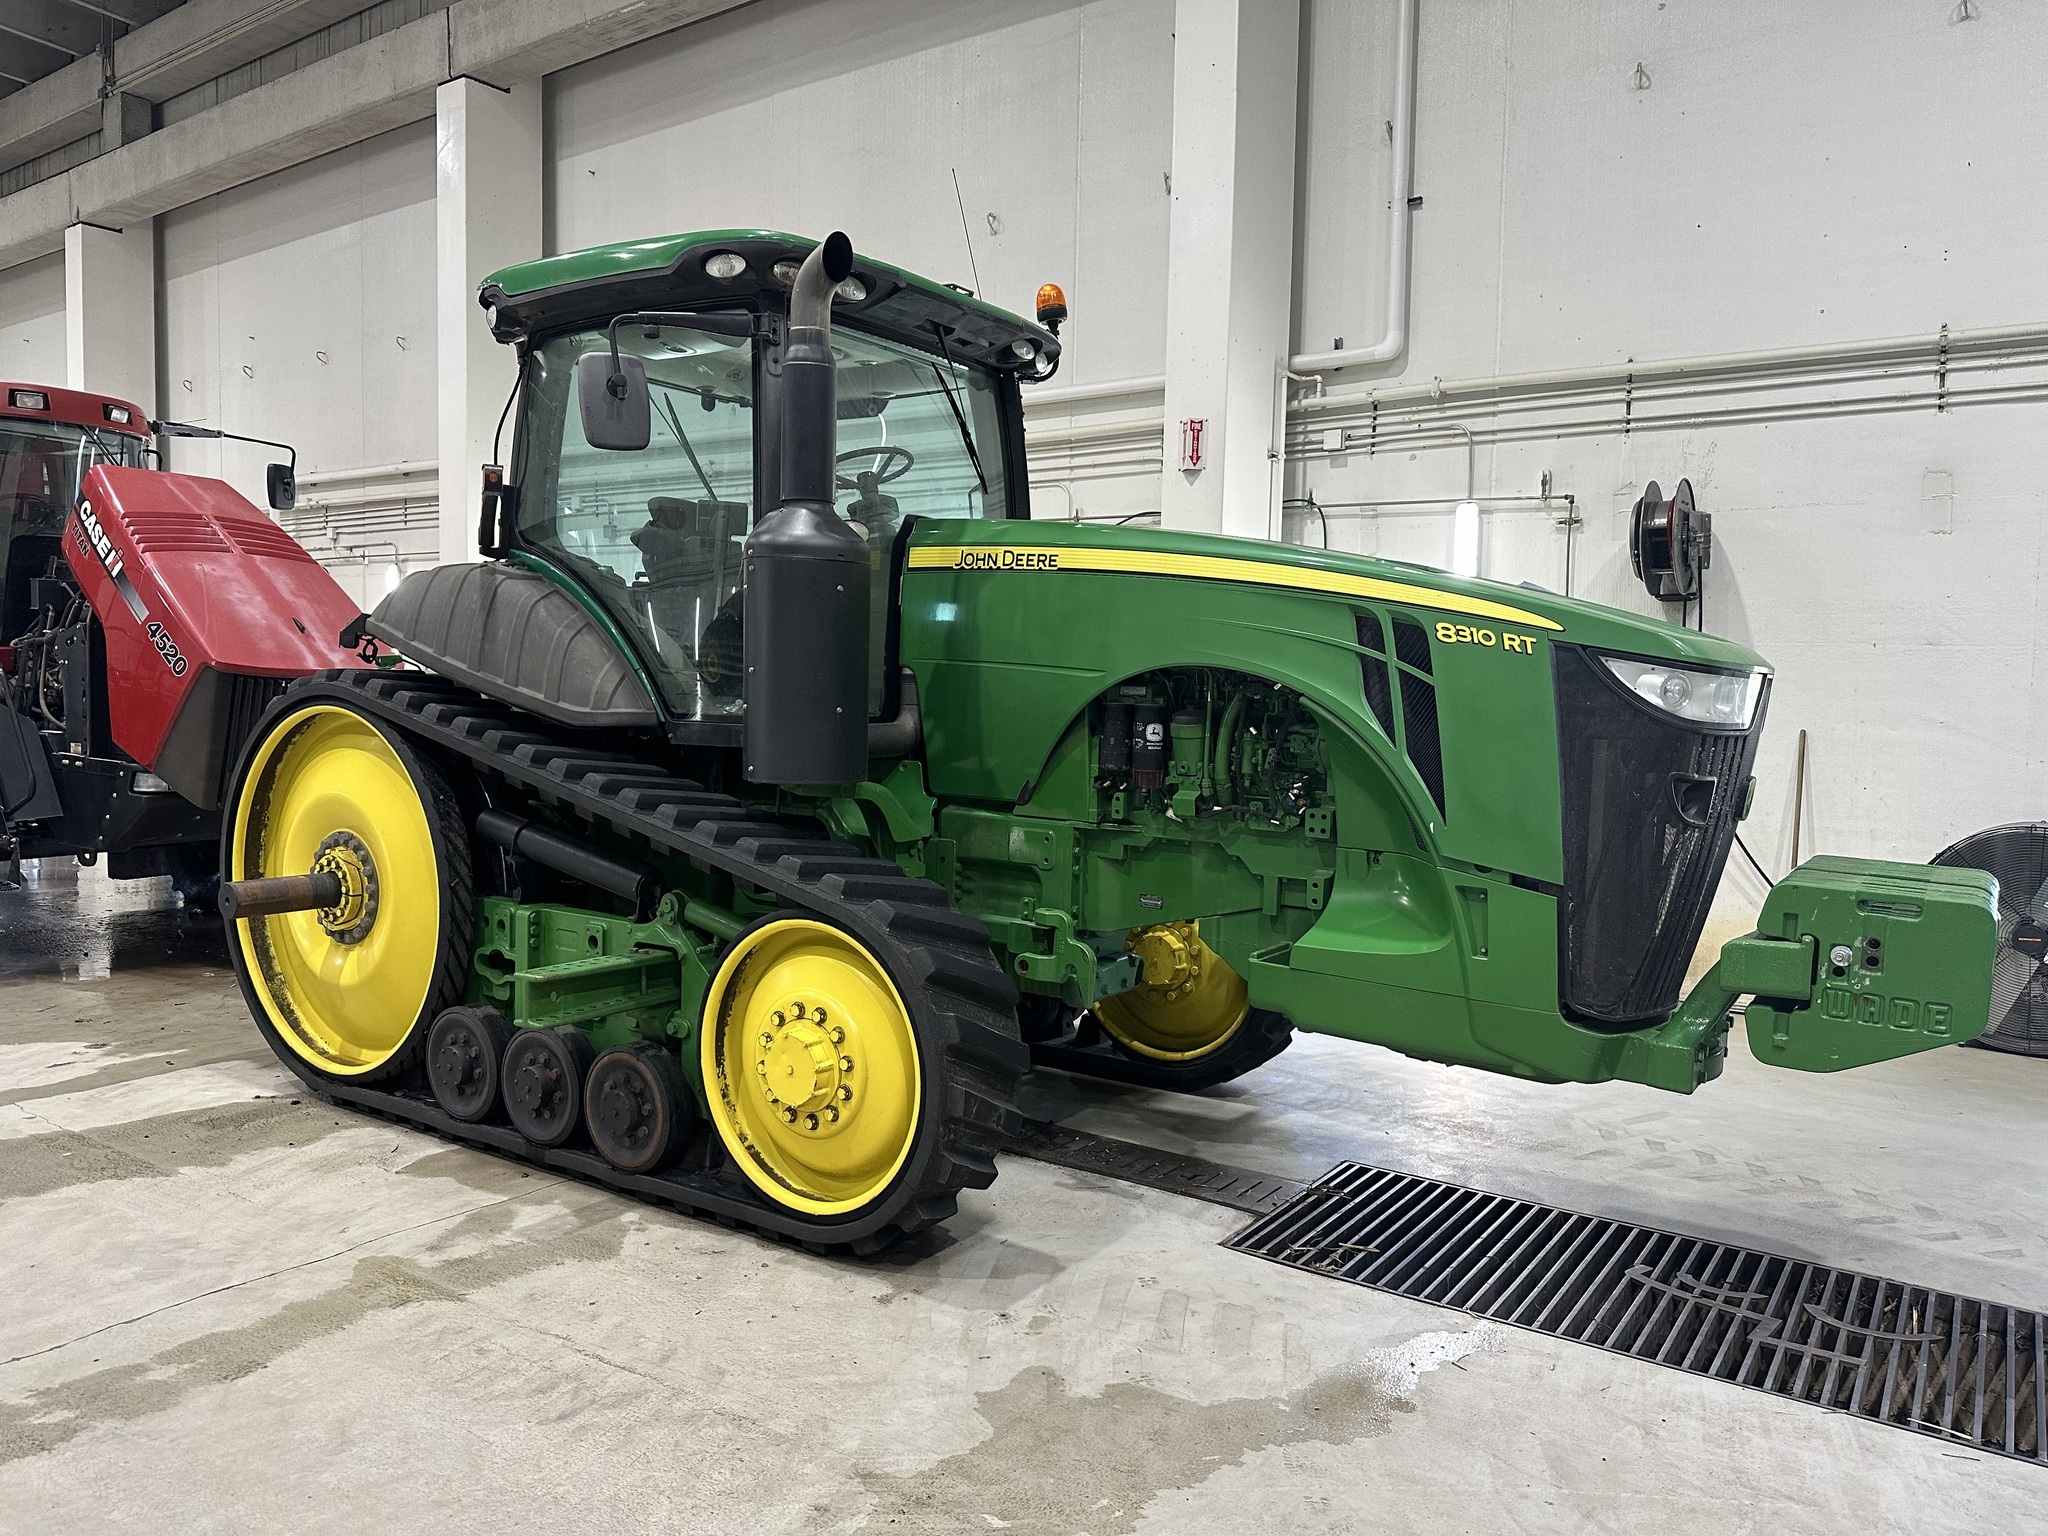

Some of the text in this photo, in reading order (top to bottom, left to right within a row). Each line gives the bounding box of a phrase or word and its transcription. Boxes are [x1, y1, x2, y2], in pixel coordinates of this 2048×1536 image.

[71, 521, 90, 559] TITAN
[79, 500, 112, 560] CASE
[954, 549, 1059, 568] JOHN DEERE
[146, 621, 188, 677] 4520
[1435, 622, 1537, 655] 8310 RT
[1822, 988, 1952, 1036] WADE
